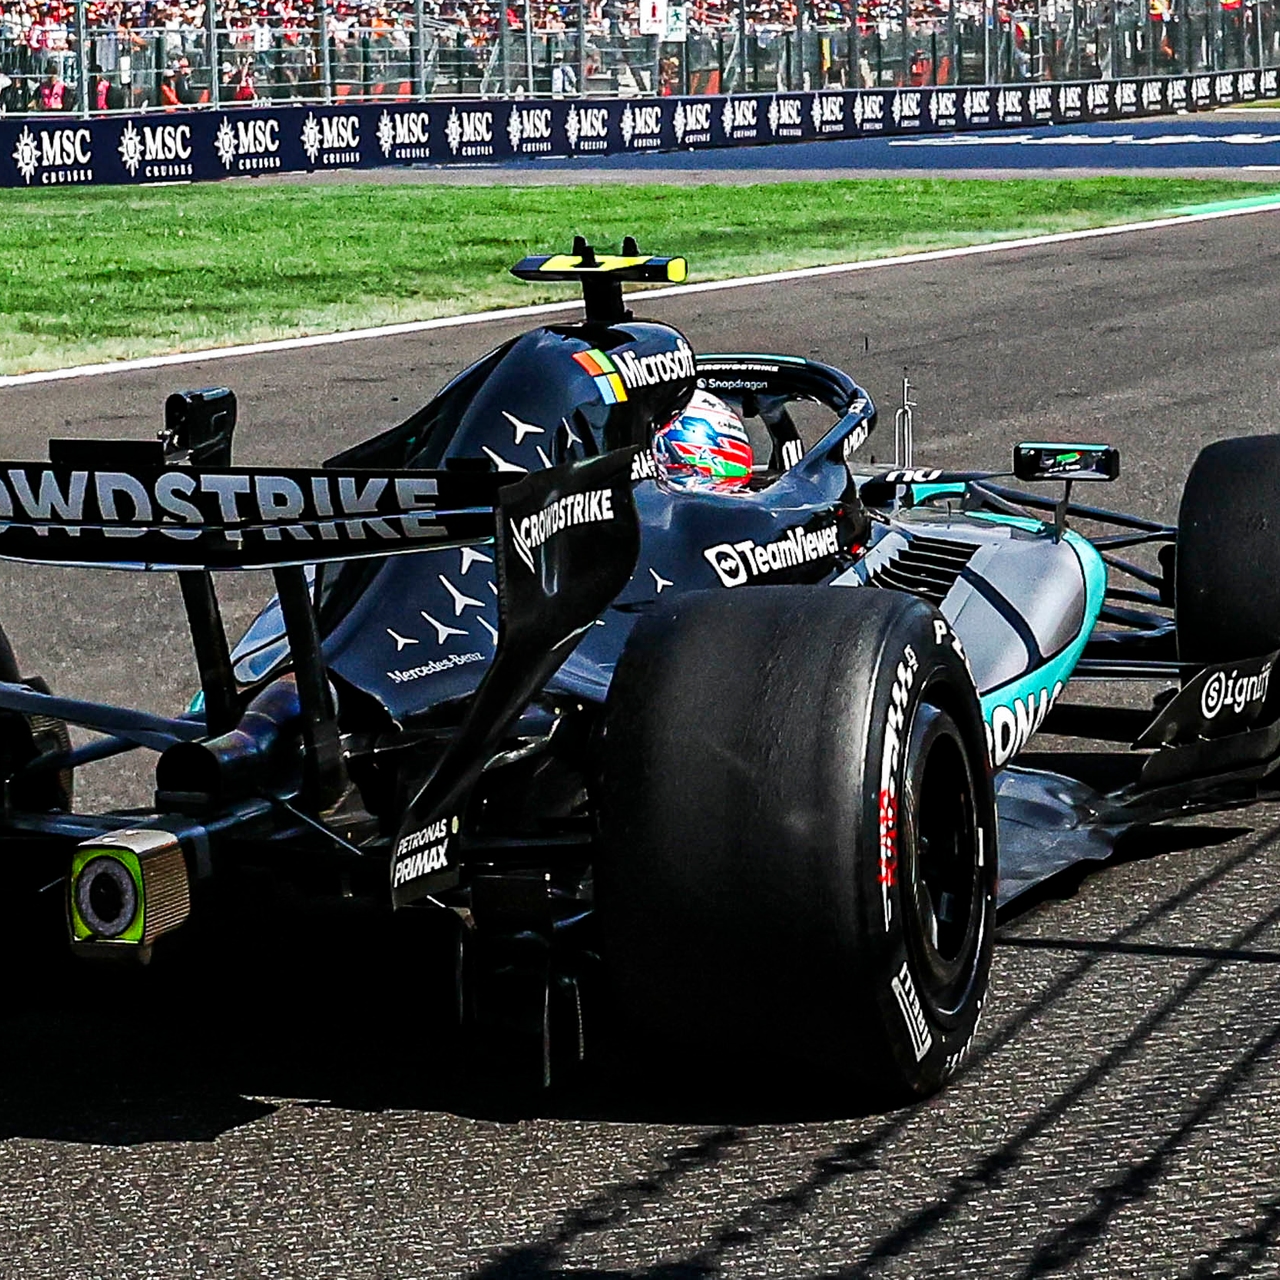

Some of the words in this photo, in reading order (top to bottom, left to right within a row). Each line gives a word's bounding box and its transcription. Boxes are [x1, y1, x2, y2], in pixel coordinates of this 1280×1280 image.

[462, 112, 492, 141] MSC
[522, 109, 551, 138] MSC
[579, 108, 608, 136] MSC
[635, 106, 661, 134] MSC
[686, 104, 711, 130] MSC
[734, 100, 757, 126] MSC
[779, 100, 802, 124] MSC
[144, 125, 191, 160] MSC
[237, 120, 279, 154] MSC
[322, 116, 360, 148] MSC
[394, 113, 429, 144] MSC
[40, 128, 91, 166] MSC
[613, 339, 696, 388] Microsoft
[696, 364, 779, 372] CROWDSTRIKE
[708, 378, 768, 390] Snapdragon
[520, 489, 615, 549] CROWDSTRIKE
[734, 525, 839, 576] TeamViewer
[934, 620, 948, 644] P
[387, 652, 486, 684] Mercedes-Benz
[397, 818, 447, 857] PETRONAS
[393, 837, 449, 888] PRIMAX
